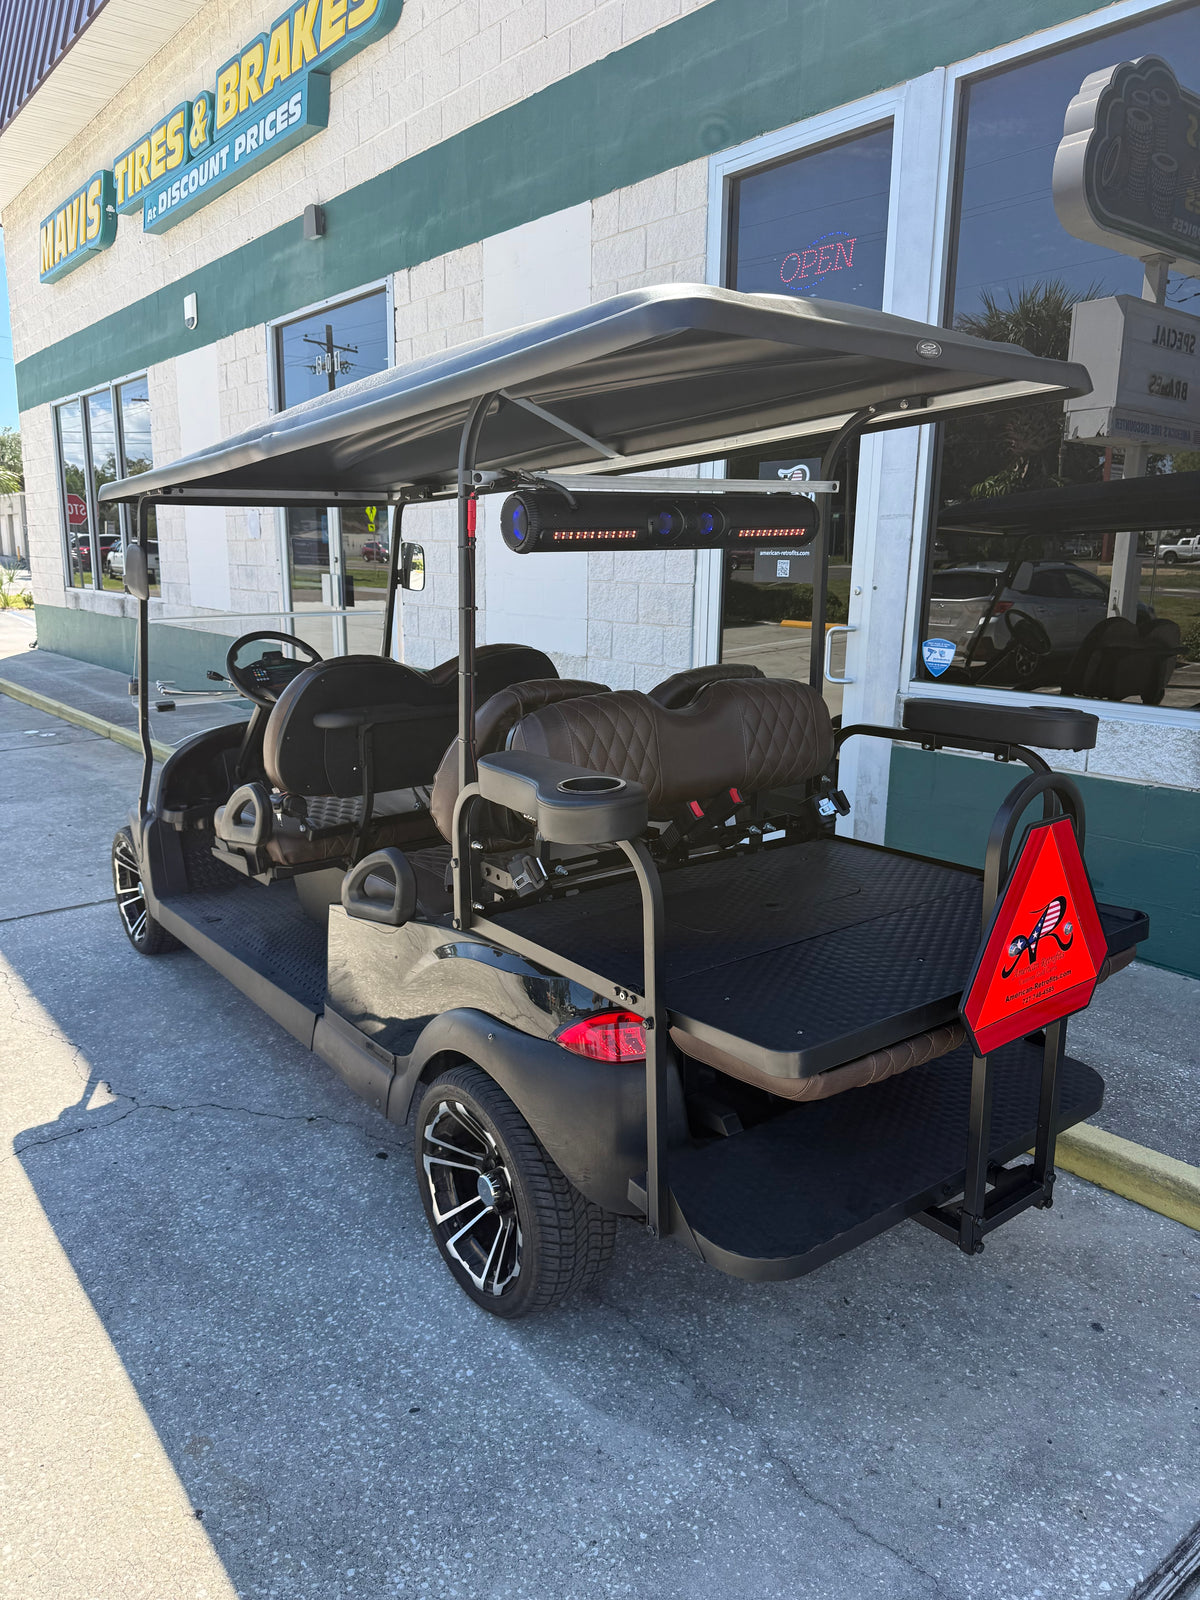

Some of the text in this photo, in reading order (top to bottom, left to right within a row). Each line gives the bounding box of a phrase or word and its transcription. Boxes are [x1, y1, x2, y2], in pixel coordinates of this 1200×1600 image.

[147, 91, 303, 223] At DISCOUNT PRICES
[40, 179, 102, 275] MAVIS
[115, 111, 185, 206] TIRES
[189, 98, 208, 150] &
[780, 238, 857, 283] OPEN
[759, 549, 811, 557] american-retrofits.com
[1005, 969, 1072, 1003] American-Retrofits.com
